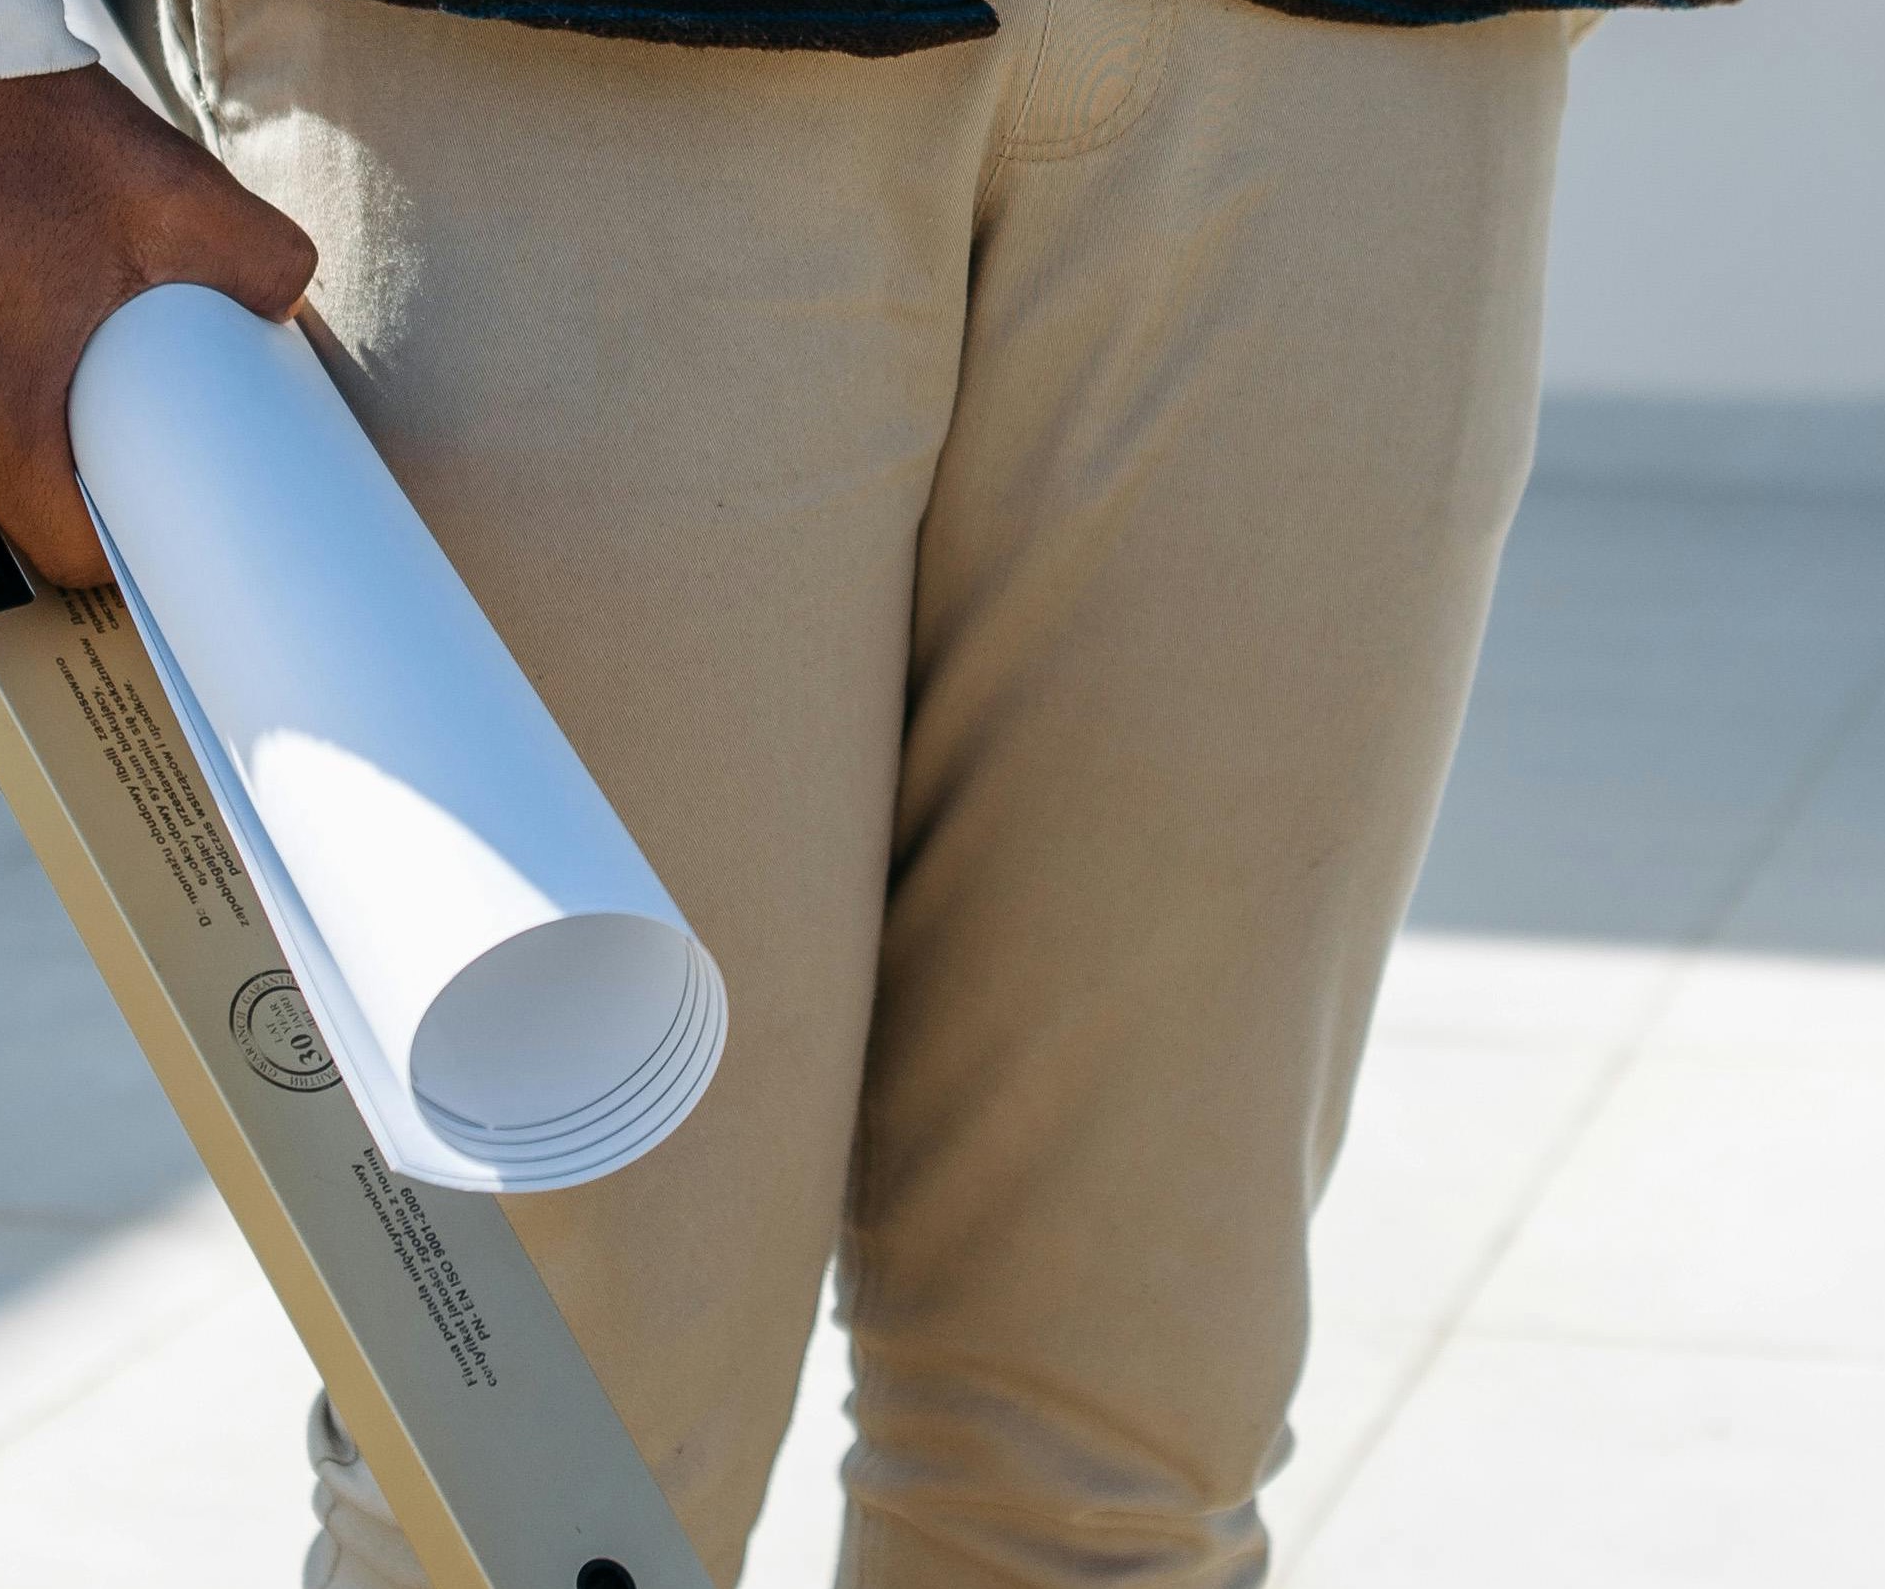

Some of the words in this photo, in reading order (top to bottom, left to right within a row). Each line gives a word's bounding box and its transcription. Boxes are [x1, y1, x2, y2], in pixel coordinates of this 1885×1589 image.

[56, 657, 108, 741] zastosowano
[125, 717, 140, 735] się
[103, 748, 130, 783] libelli
[129, 755, 159, 801] system
[138, 739, 195, 826] przestawianiu
[162, 752, 205, 819] wstrząsów
[127, 786, 165, 844] obudowy
[156, 806, 207, 885] epoksydowy
[203, 822, 241, 876] podczas
[163, 848, 197, 904] montażu
[191, 835, 249, 925] zapobiegający
[270, 1003, 291, 1034] YEAR
[290, 1034, 323, 1066] 30
[352, 1165, 421, 1282] międzynarodowy
[396, 1209, 430, 1263] zgodnie
[401, 1188, 445, 1258] 9001-2009
[424, 1267, 463, 1318] jakości
[441, 1261, 460, 1287] ISO
[456, 1289, 474, 1311] EN
[418, 1284, 456, 1341] posiada
[451, 1344, 477, 1387] Firma
[455, 1320, 497, 1386] certyfikat
